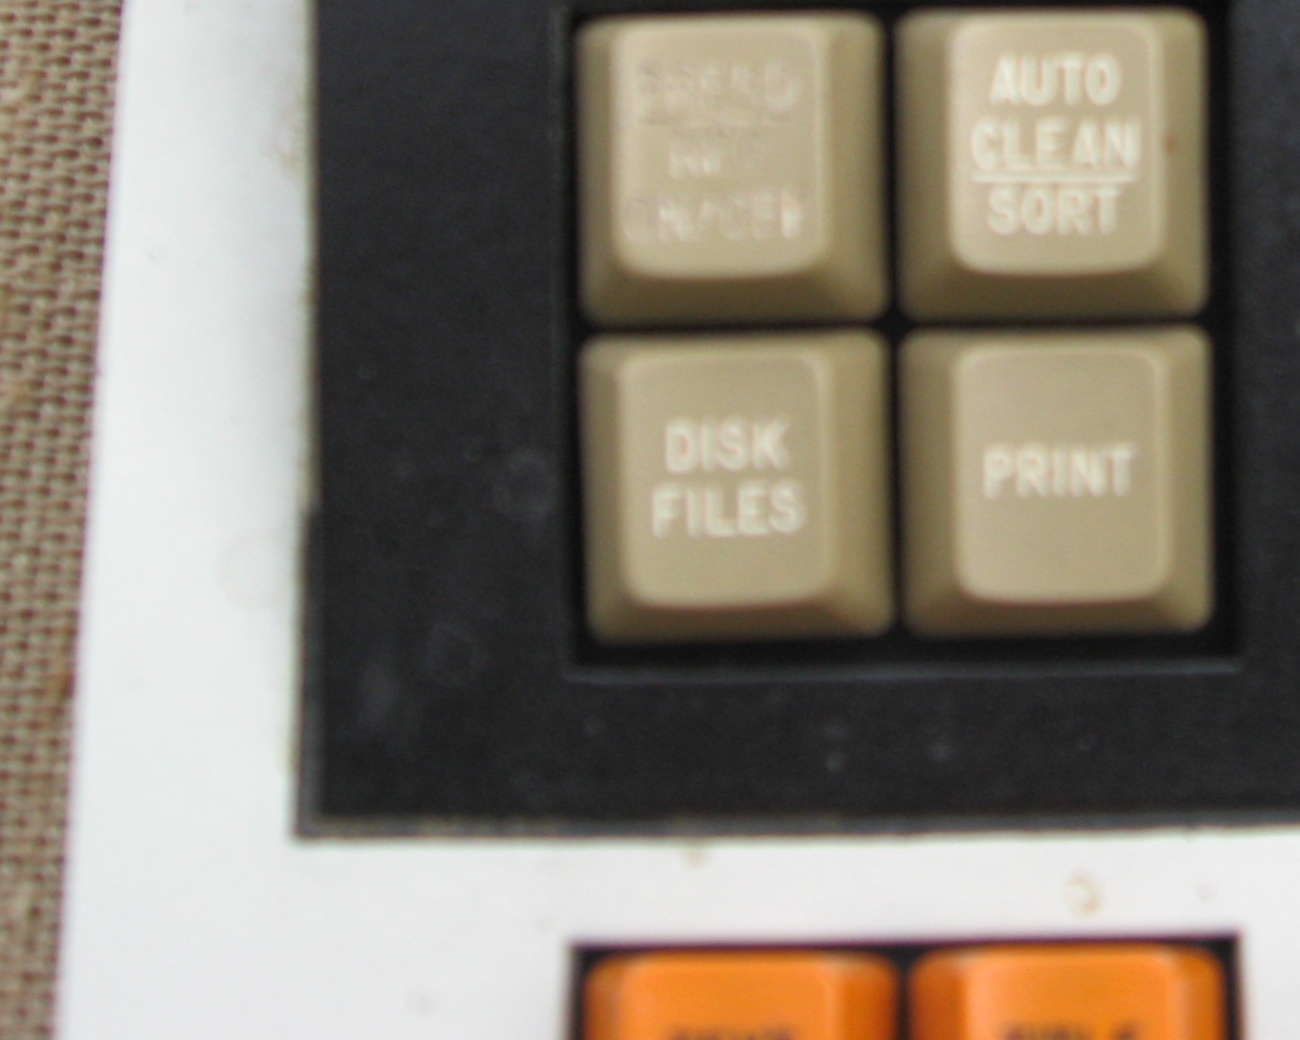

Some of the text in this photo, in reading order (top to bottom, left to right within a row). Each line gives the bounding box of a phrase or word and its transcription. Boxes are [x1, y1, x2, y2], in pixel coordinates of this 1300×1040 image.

[989, 54, 1122, 106] AUTO
[971, 116, 1142, 170] CLEAN
[987, 186, 1120, 236] SORT
[664, 417, 791, 473] DISK
[983, 443, 1136, 499] PRINT
[651, 481, 802, 538] FILES
